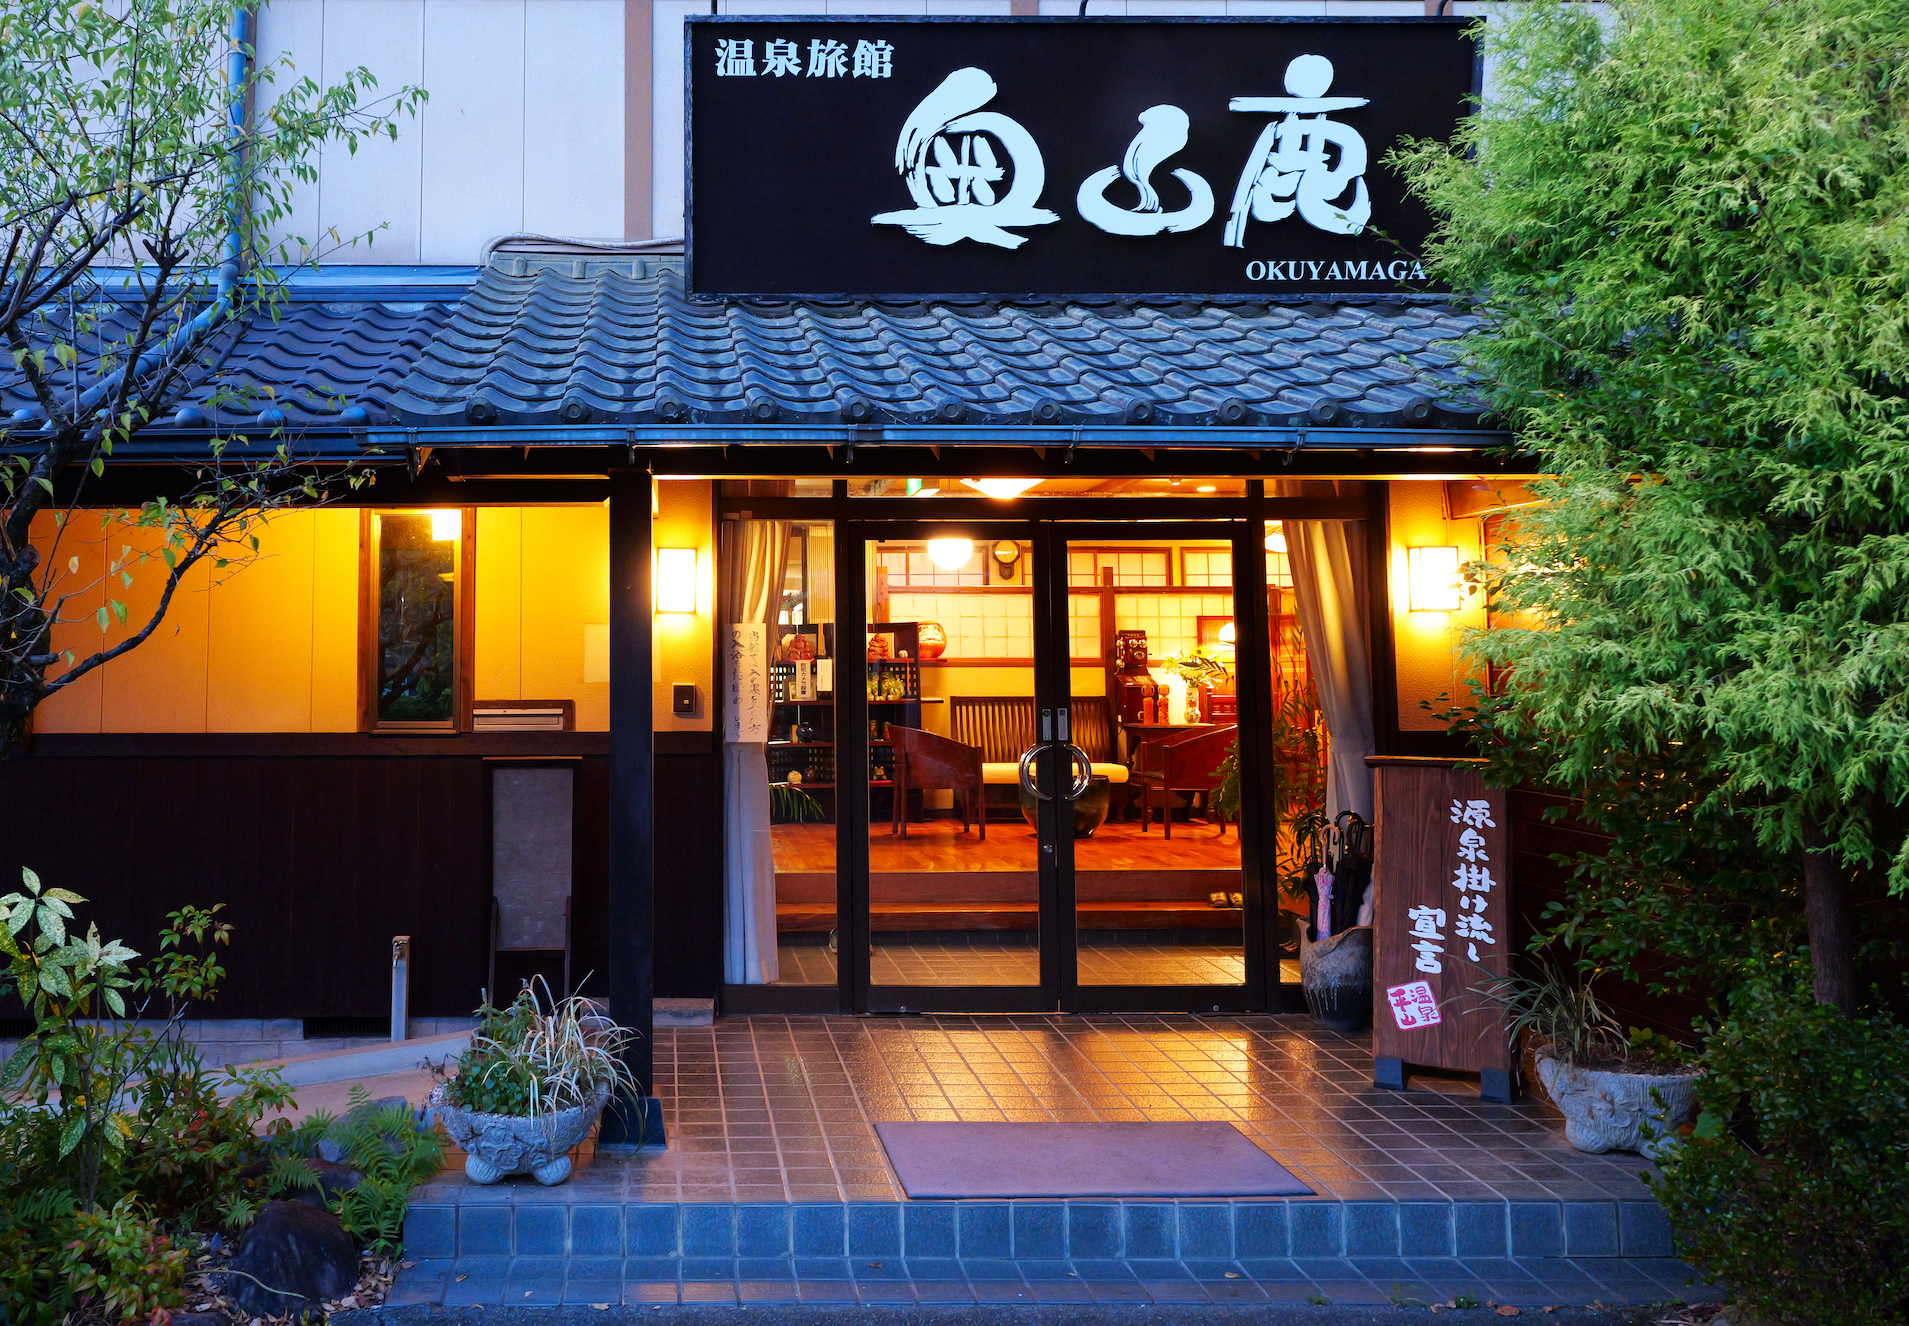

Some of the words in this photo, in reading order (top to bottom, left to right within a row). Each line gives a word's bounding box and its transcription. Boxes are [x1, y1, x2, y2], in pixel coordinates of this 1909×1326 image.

[714, 38, 895, 79] 温泉旅館
[1245, 260, 1427, 281] OKUYAMAGA
[1450, 799, 1496, 962] 源泉掛け流し
[1408, 905, 1446, 974] 宣言
[1409, 986, 1439, 1022] 温泉
